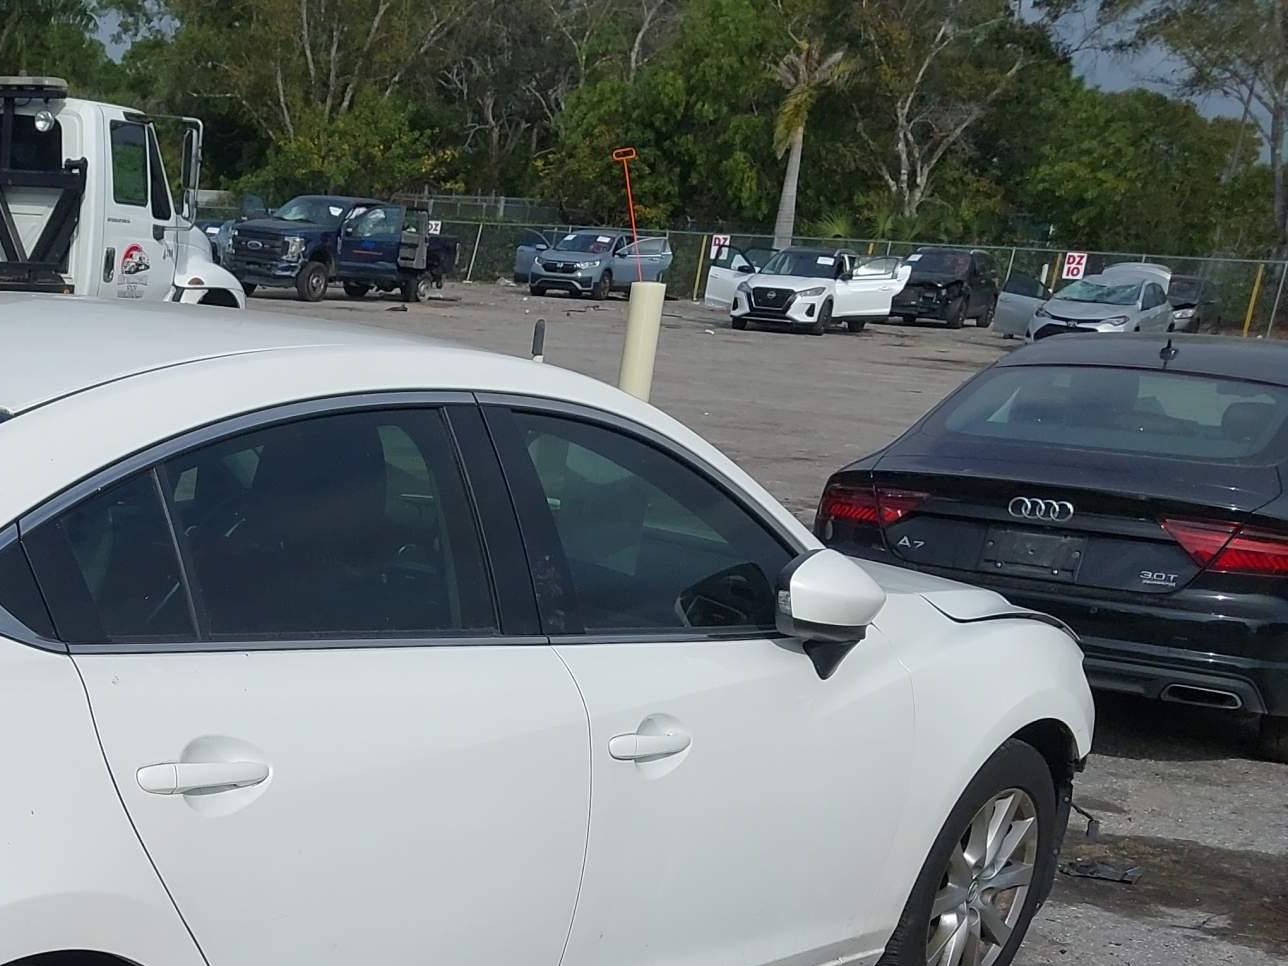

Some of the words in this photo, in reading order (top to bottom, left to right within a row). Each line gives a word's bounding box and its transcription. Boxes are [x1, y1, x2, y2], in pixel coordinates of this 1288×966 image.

[713, 237, 729, 246] DZ
[1067, 255, 1085, 265] DZ
[897, 536, 925, 549] A7
